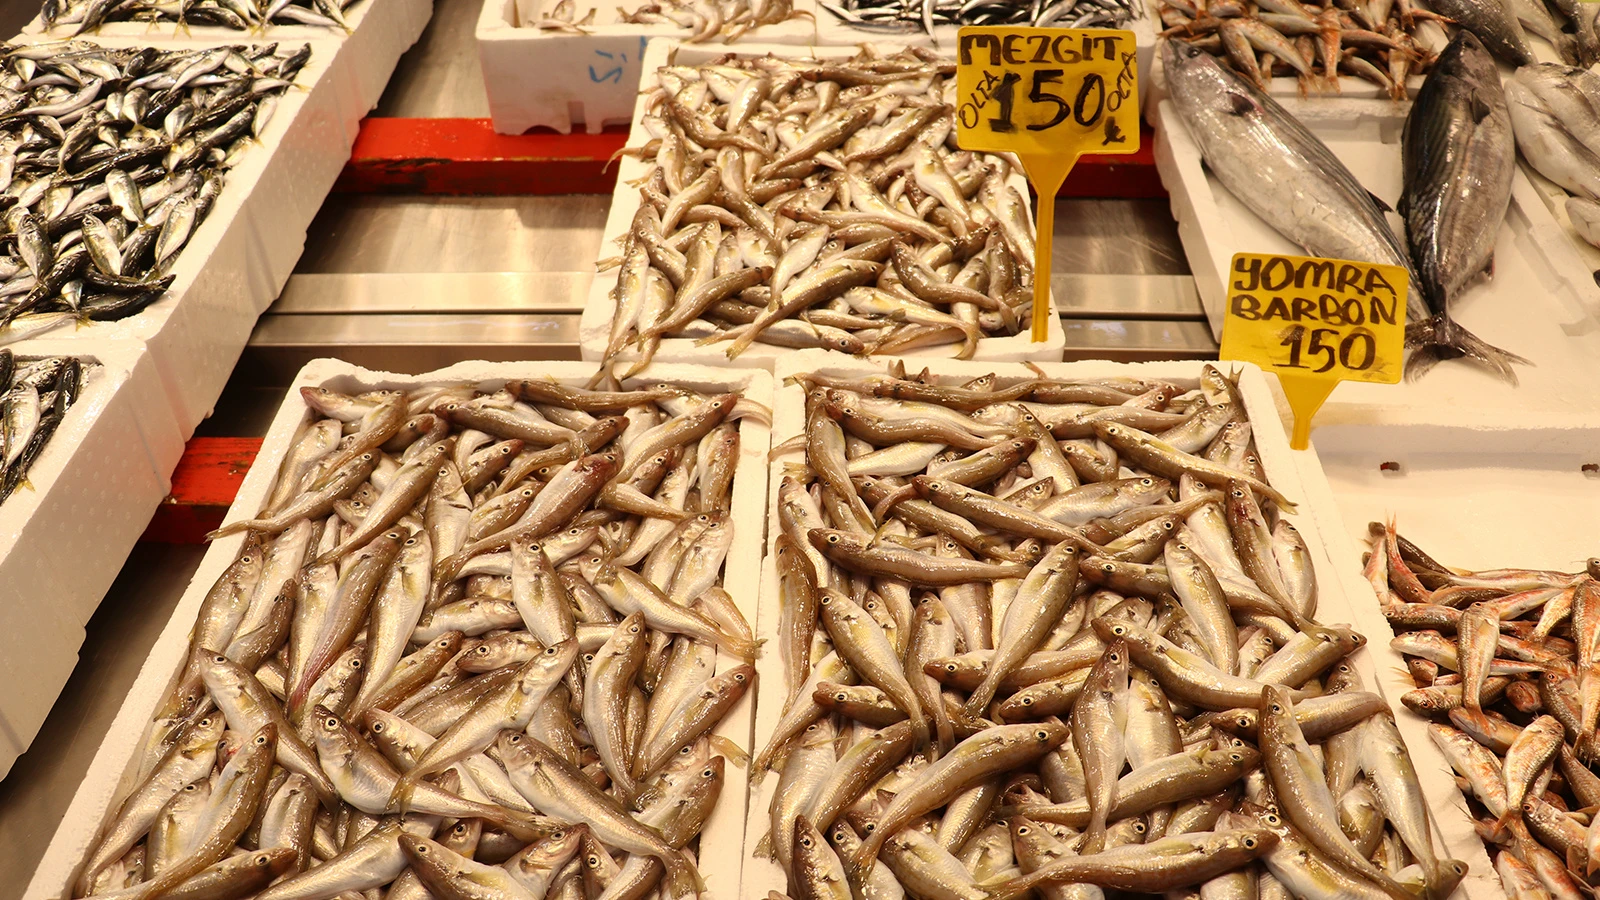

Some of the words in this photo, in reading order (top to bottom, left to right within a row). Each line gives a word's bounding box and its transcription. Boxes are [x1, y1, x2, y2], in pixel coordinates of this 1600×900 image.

[958, 70, 1001, 129] OLTA
[987, 69, 1106, 133] 150
[1233, 257, 1398, 296] YOMRA
[1230, 294, 1398, 327] BARBON
[1272, 324, 1377, 373] 150
